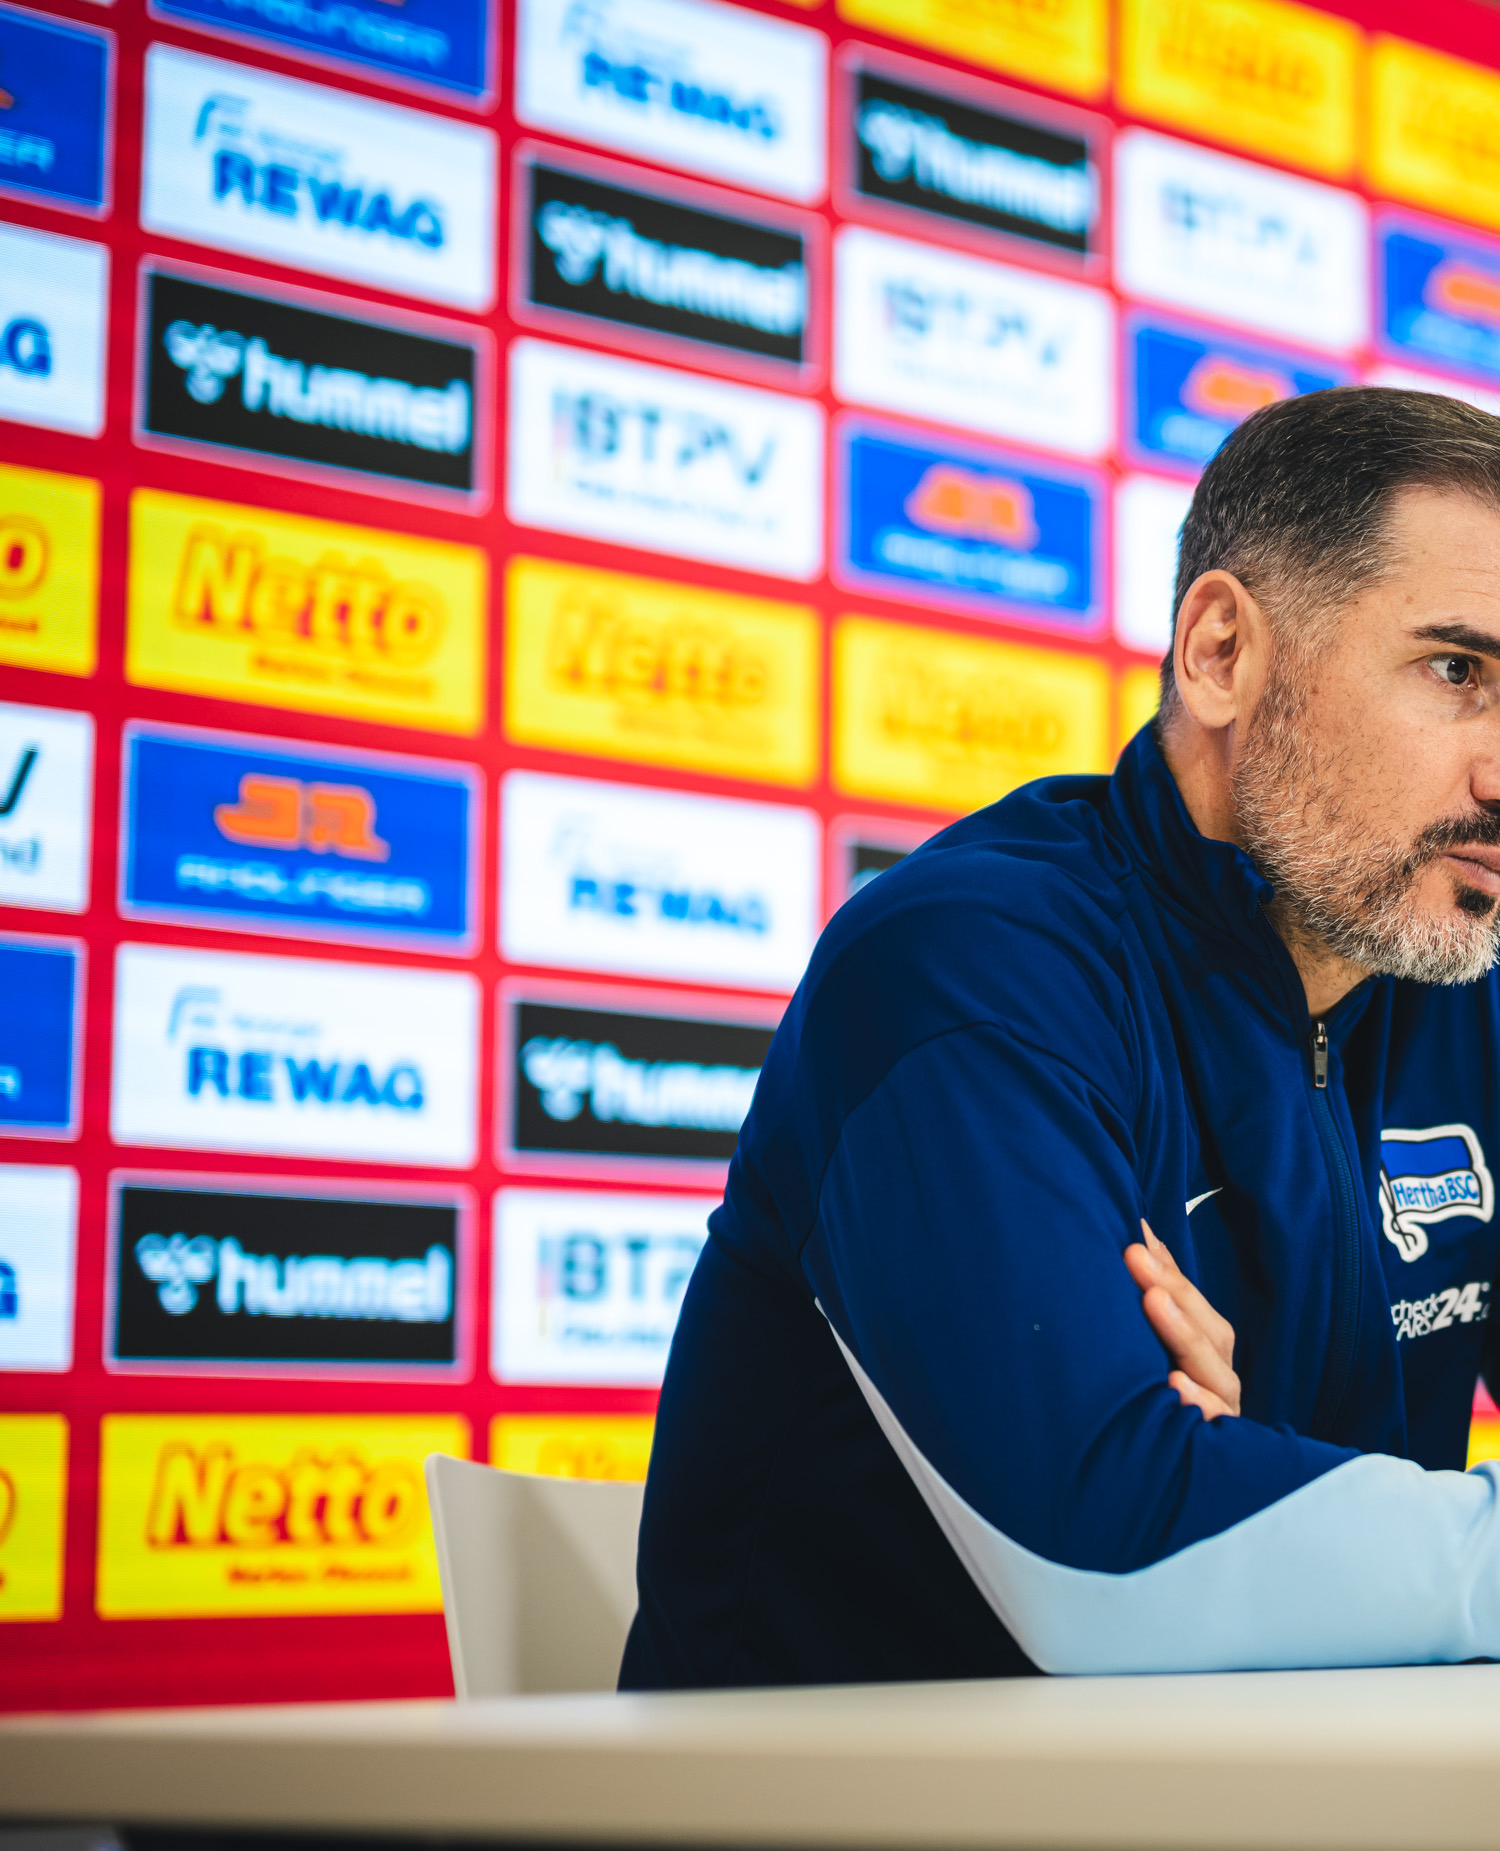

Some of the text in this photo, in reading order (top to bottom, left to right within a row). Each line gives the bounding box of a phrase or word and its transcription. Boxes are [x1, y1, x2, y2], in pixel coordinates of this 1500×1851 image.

[213, 148, 446, 250] REWAG
[241, 335, 472, 455] hummel
[173, 520, 445, 667] Netto
[187, 1045, 426, 1112] REWAG
[1444, 1175, 1479, 1200] BSC
[217, 1235, 453, 1324] hummel
[147, 1440, 428, 1551] Netto
